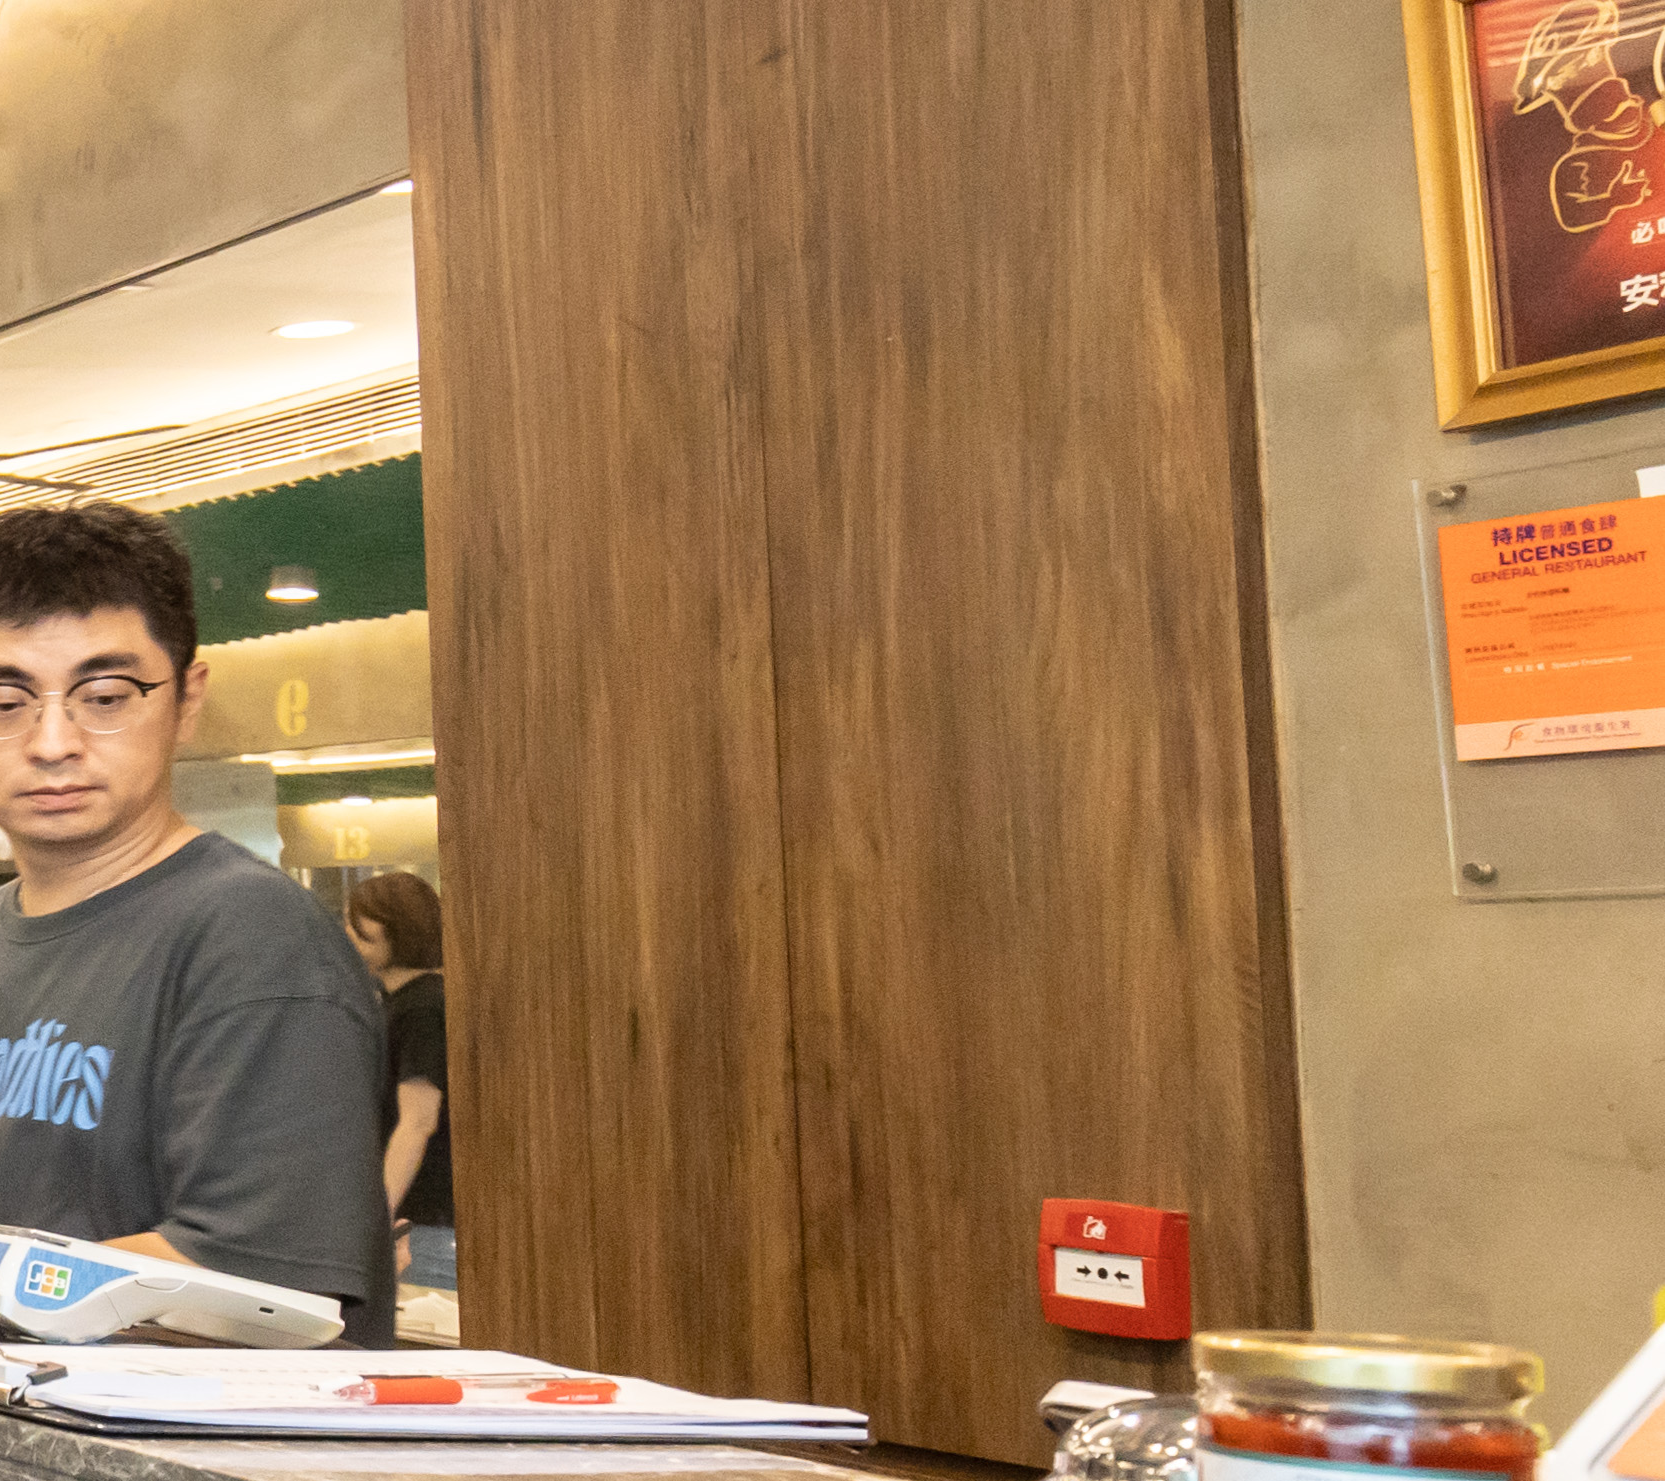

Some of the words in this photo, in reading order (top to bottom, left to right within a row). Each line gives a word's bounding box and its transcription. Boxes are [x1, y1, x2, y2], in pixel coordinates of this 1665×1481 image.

[1499, 537, 1613, 565] LICENSED
[1471, 567, 1539, 584] GENERAL
[1545, 551, 1647, 576] RESTAURANT
